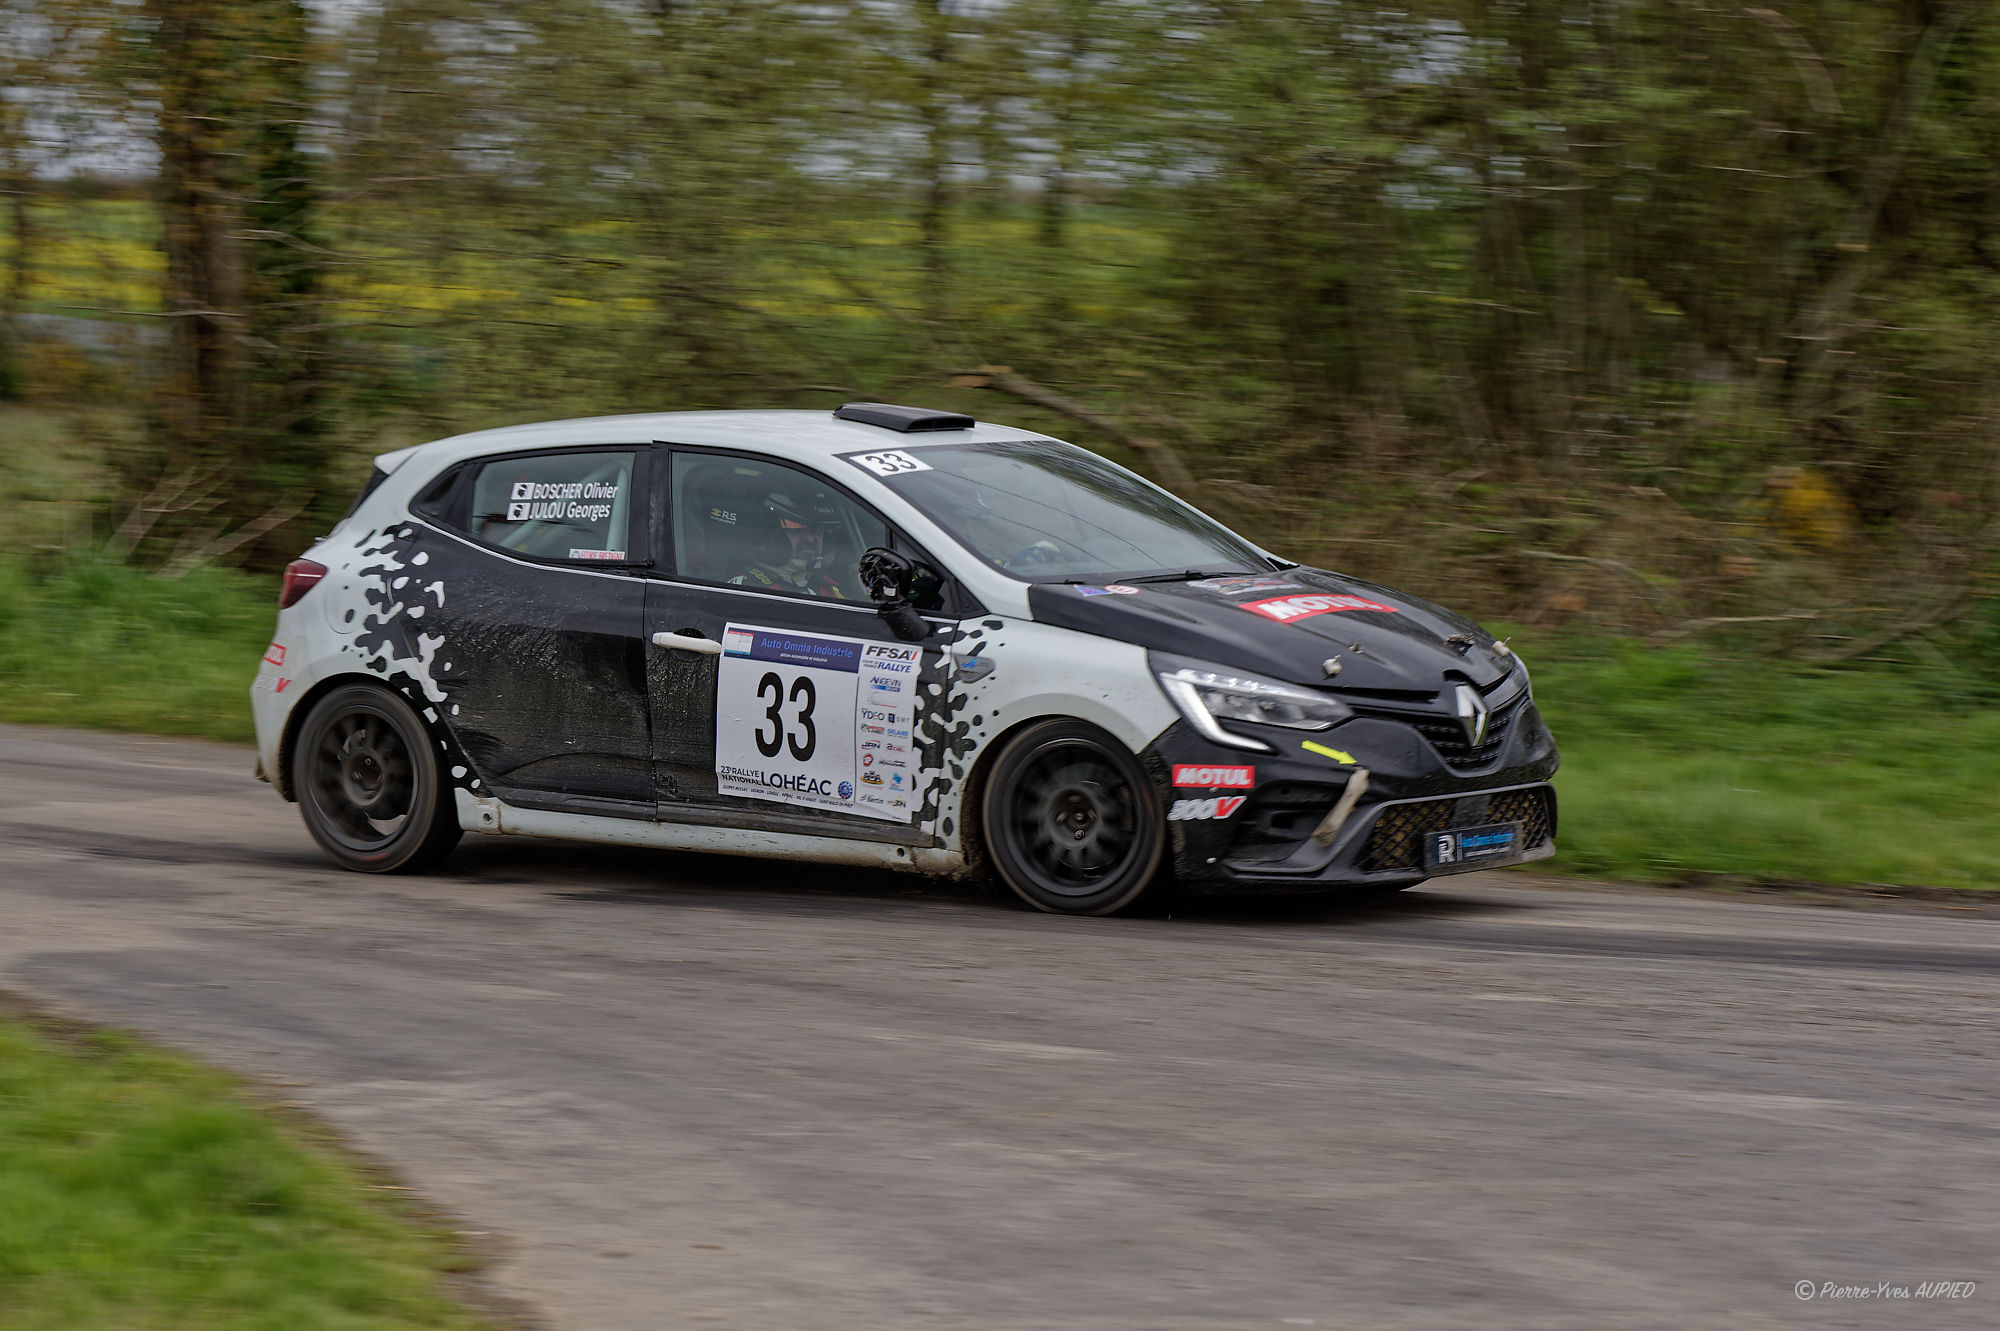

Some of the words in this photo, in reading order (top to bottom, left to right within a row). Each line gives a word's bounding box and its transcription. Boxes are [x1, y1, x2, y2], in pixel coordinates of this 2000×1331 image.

[865, 453, 917, 472] 33
[533, 483, 583, 499] BOSCHER
[584, 482, 619, 499] Olivier
[529, 502, 567, 519] JULOU
[567, 501, 611, 522] Georges
[1257, 596, 1384, 620] MOTUL
[761, 638, 781, 649] Auto
[783, 640, 811, 653] Omnia
[813, 644, 854, 658] Industrie
[866, 645, 911, 660] FFSA
[878, 662, 912, 673] RALLYE
[755, 671, 817, 762] 33
[722, 774, 761, 786] NATIONAL
[732, 767, 759, 778] RALLYE
[1176, 768, 1252, 785] MOTUL
[761, 771, 832, 796] LOHÉAC
